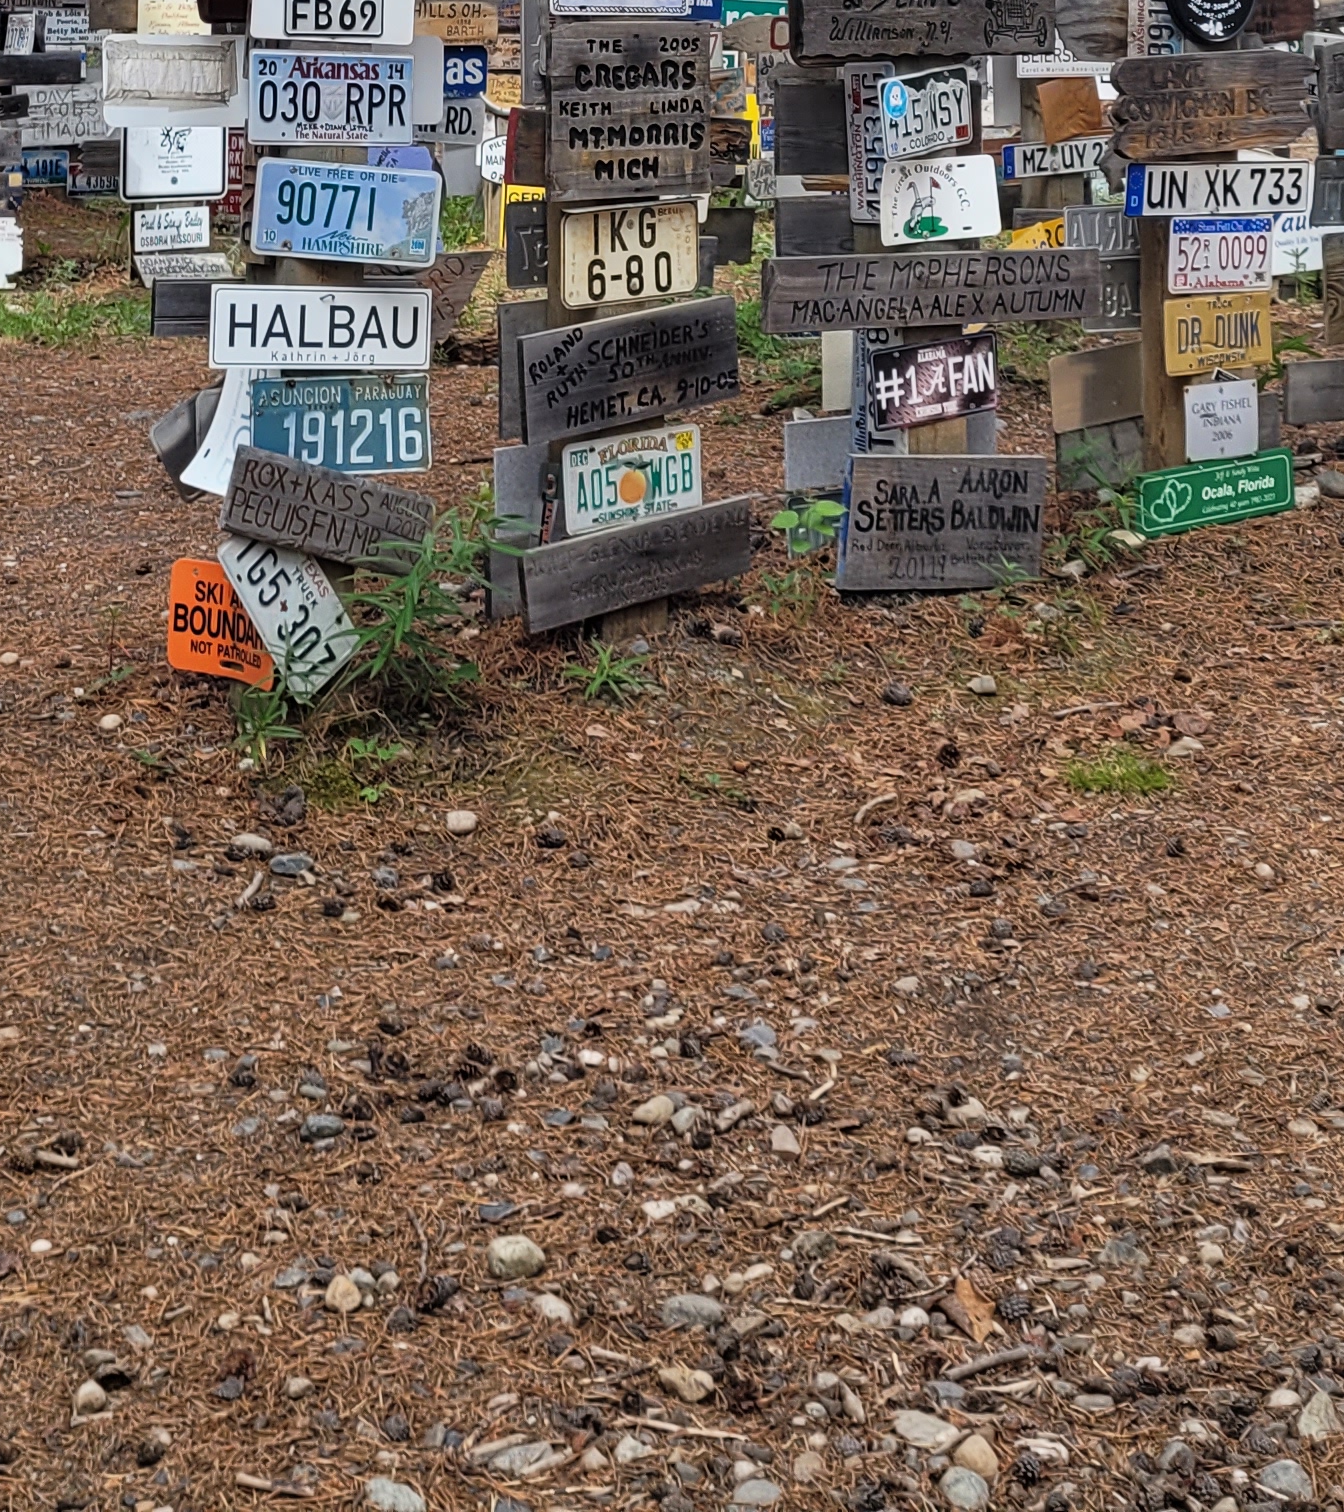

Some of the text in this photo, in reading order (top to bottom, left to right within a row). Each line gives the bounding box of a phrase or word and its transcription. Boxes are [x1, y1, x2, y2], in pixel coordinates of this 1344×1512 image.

[292, 0, 376, 32] FB69
[288, 57, 380, 81] Arkansas
[575, 63, 696, 91] CREGARS
[259, 80, 405, 126] 030 RPR
[559, 100, 704, 115] KEITH LINDA
[594, 158, 658, 181] MICH
[1146, 168, 1304, 207] UN XK 733
[278, 180, 377, 231] 90771
[588, 264, 672, 300] 6-80
[229, 305, 419, 349] HALBAU
[1177, 312, 1261, 354] DR DUNK
[567, 394, 631, 430] HEMET,
[282, 411, 423, 466] 191216
[1238, 476, 1275, 496] Florida
[190, 640, 214, 655] NOT
